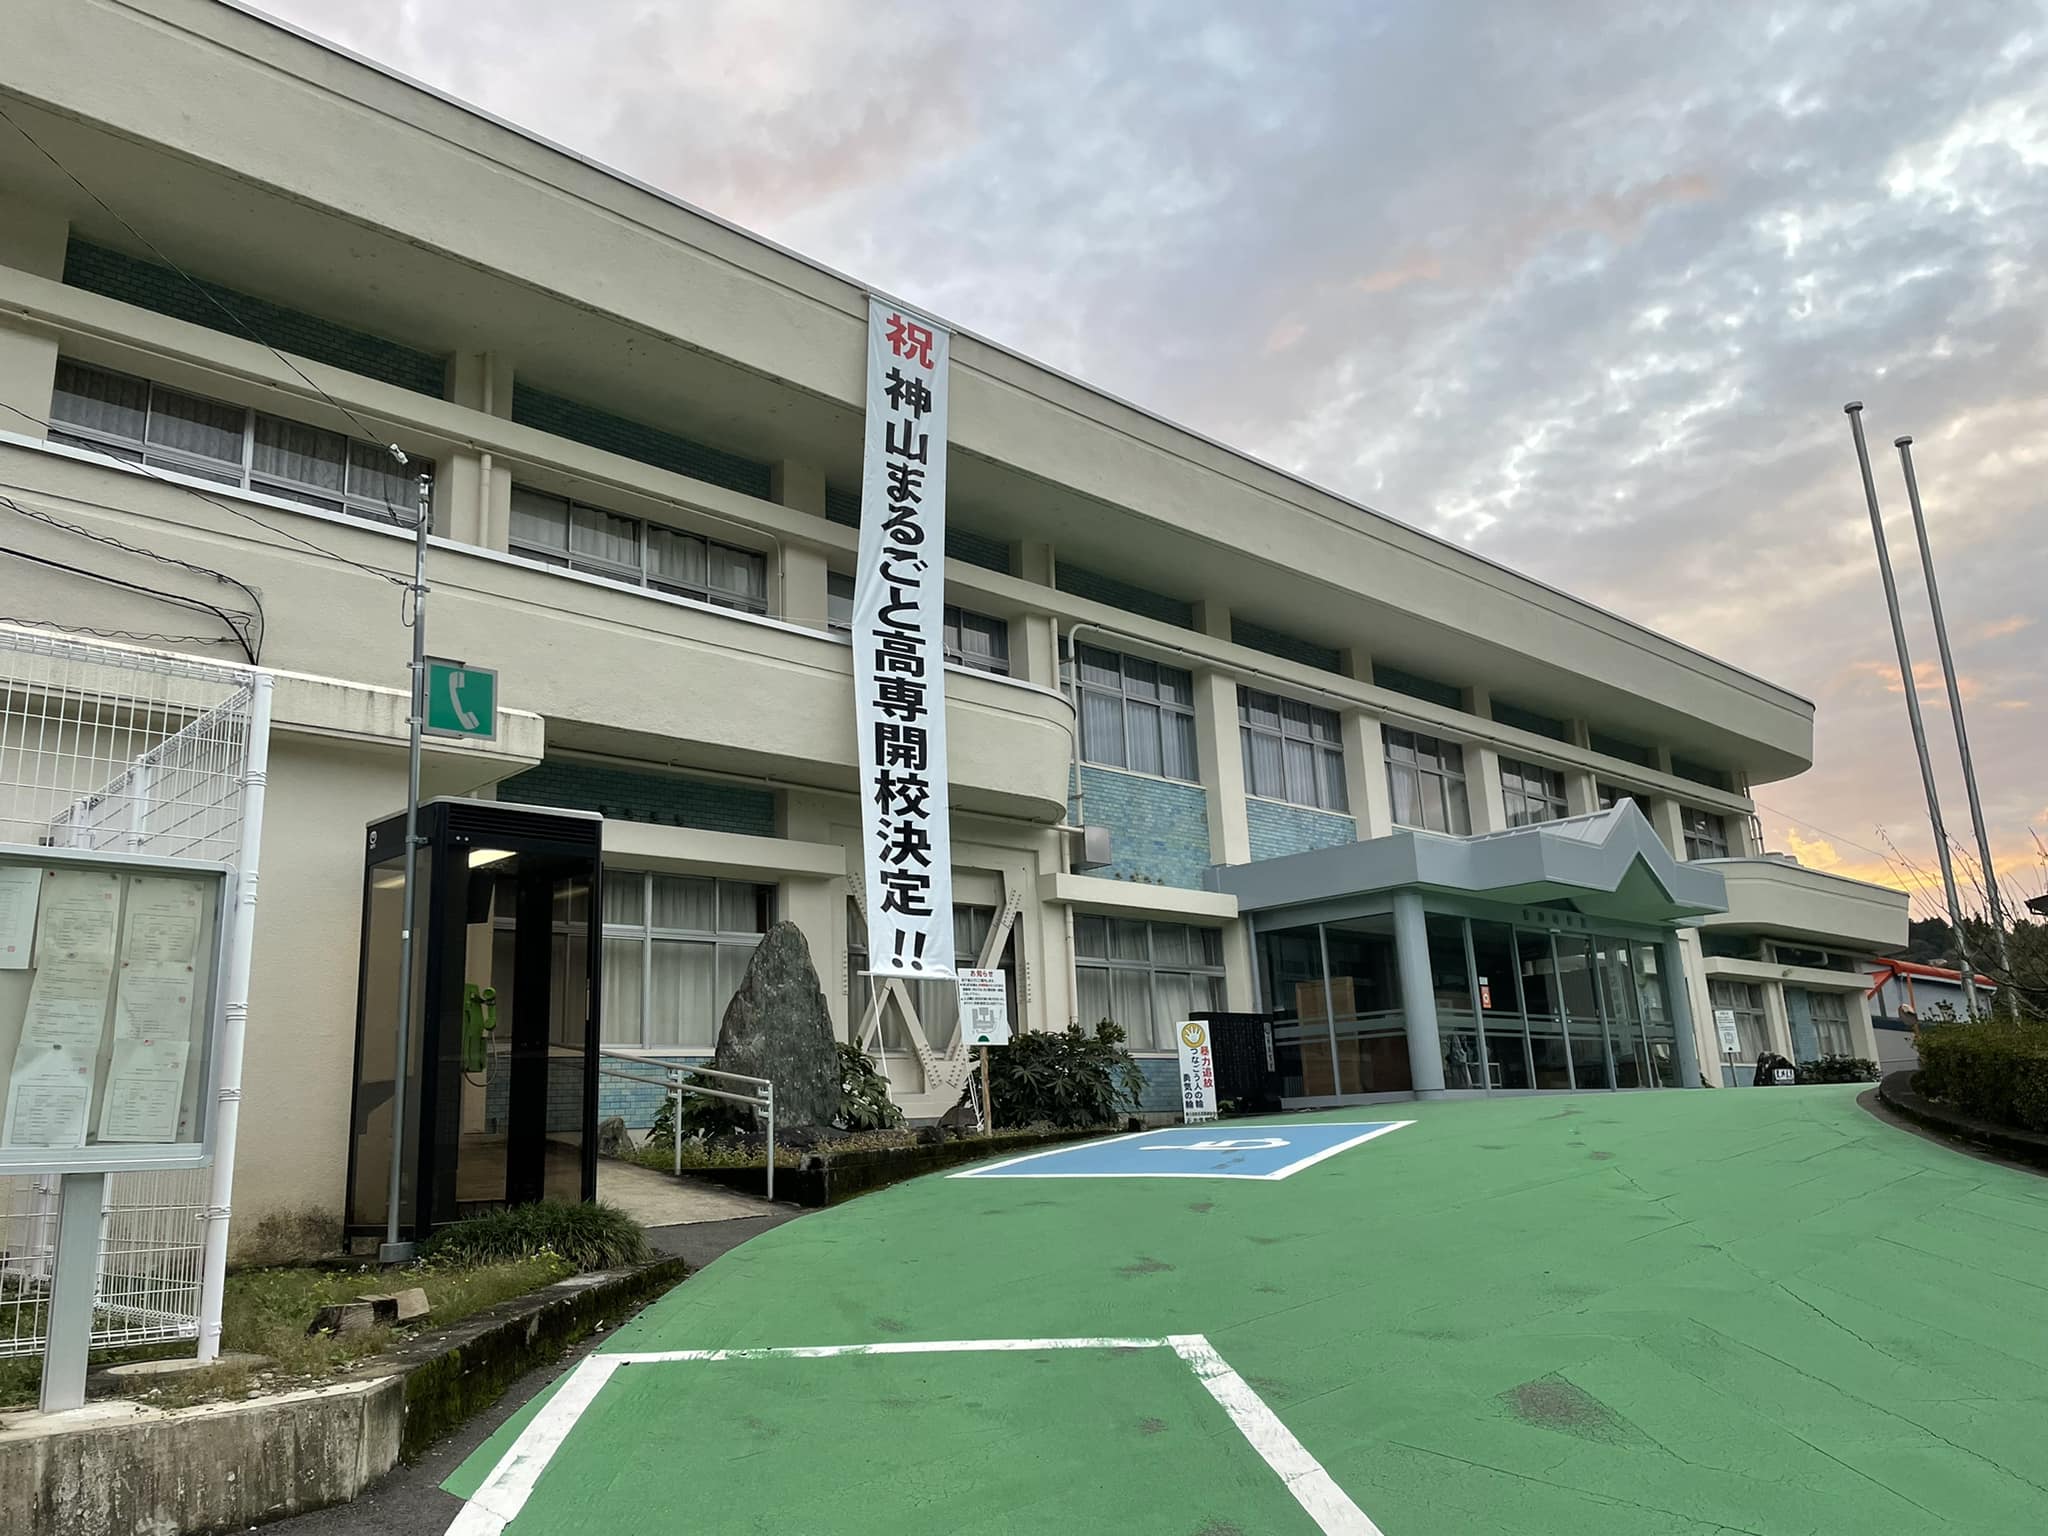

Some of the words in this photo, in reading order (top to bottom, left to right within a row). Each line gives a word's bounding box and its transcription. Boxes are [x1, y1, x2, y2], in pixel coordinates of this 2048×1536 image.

[1190, 1048, 1204, 1108] つなごう人の輪
[1200, 1046, 1213, 1088] 暴力追放
